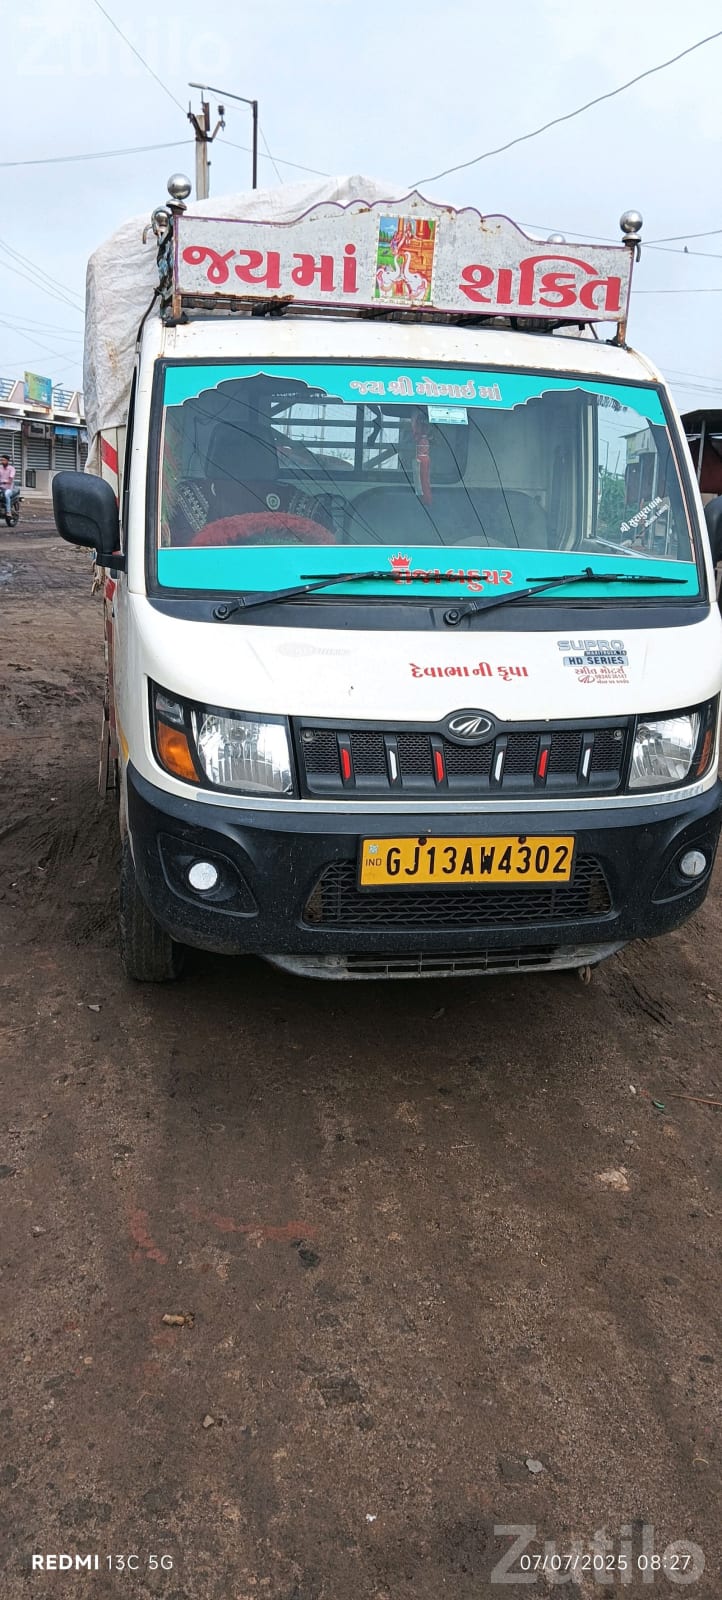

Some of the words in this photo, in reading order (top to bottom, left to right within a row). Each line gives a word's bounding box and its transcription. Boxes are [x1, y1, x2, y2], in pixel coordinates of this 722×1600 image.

[182, 245, 282, 289] જય
[291, 243, 360, 294] માં
[349, 380, 386, 396] જય
[388, 375, 415, 397] શ્રી
[478, 383, 503, 402] માં
[557, 639, 625, 651] SUPRO
[568, 656, 584, 665] HD
[587, 656, 625, 665] SERIES
[365, 858, 382, 867] IND
[386, 845, 569, 876] GJ13AW4302
